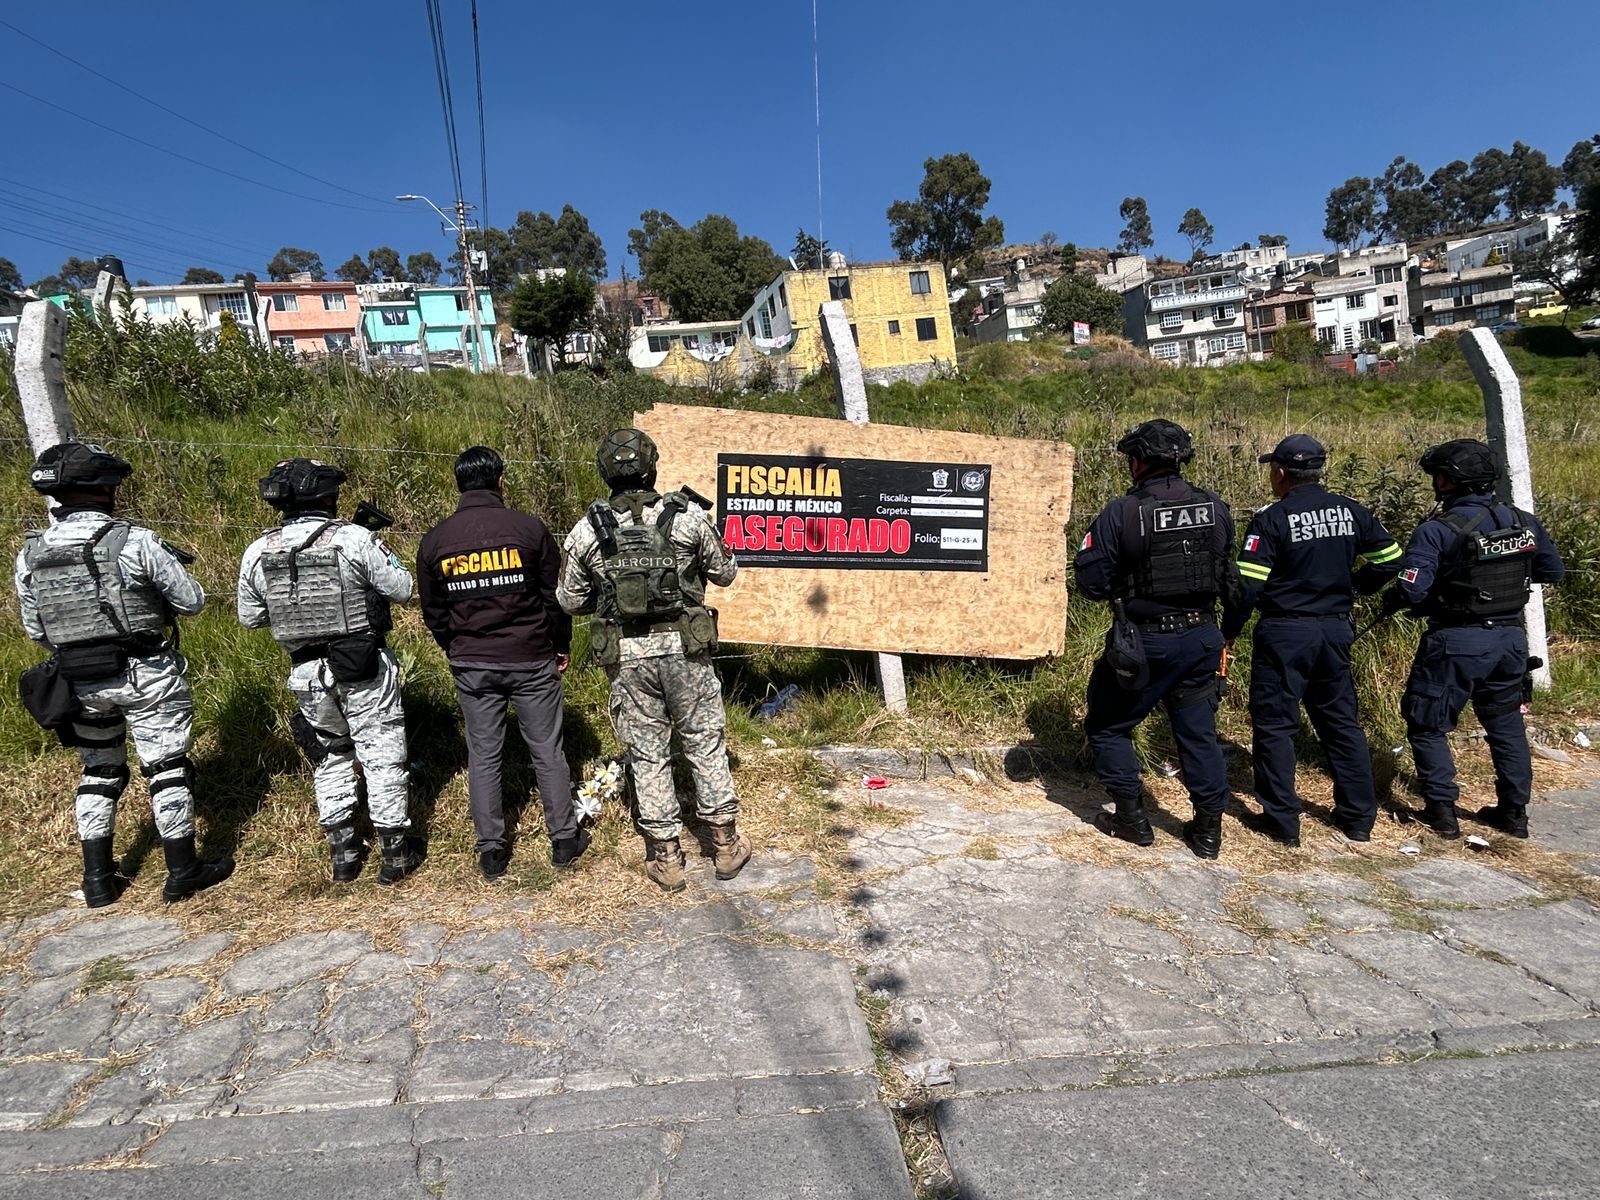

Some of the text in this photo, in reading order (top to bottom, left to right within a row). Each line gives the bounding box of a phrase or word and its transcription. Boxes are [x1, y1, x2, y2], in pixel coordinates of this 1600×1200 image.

[727, 464, 842, 497] FISCALÍA
[726, 498, 842, 514] ESTADO DE MÉXICO
[879, 493, 911, 503] Fiscalía:
[876, 505, 910, 517] Carpeta:
[1160, 507, 1210, 528] FAR
[1287, 505, 1354, 528] POLICÍA
[723, 514, 911, 554] ASEGURADO
[914, 533, 941, 544] Folio:
[1290, 521, 1356, 543] ESTATAL
[1482, 538, 1536, 555] TOLUCA
[441, 547, 523, 577] FISCALÍA
[447, 573, 524, 592] ESTADO DE MÉXICO
